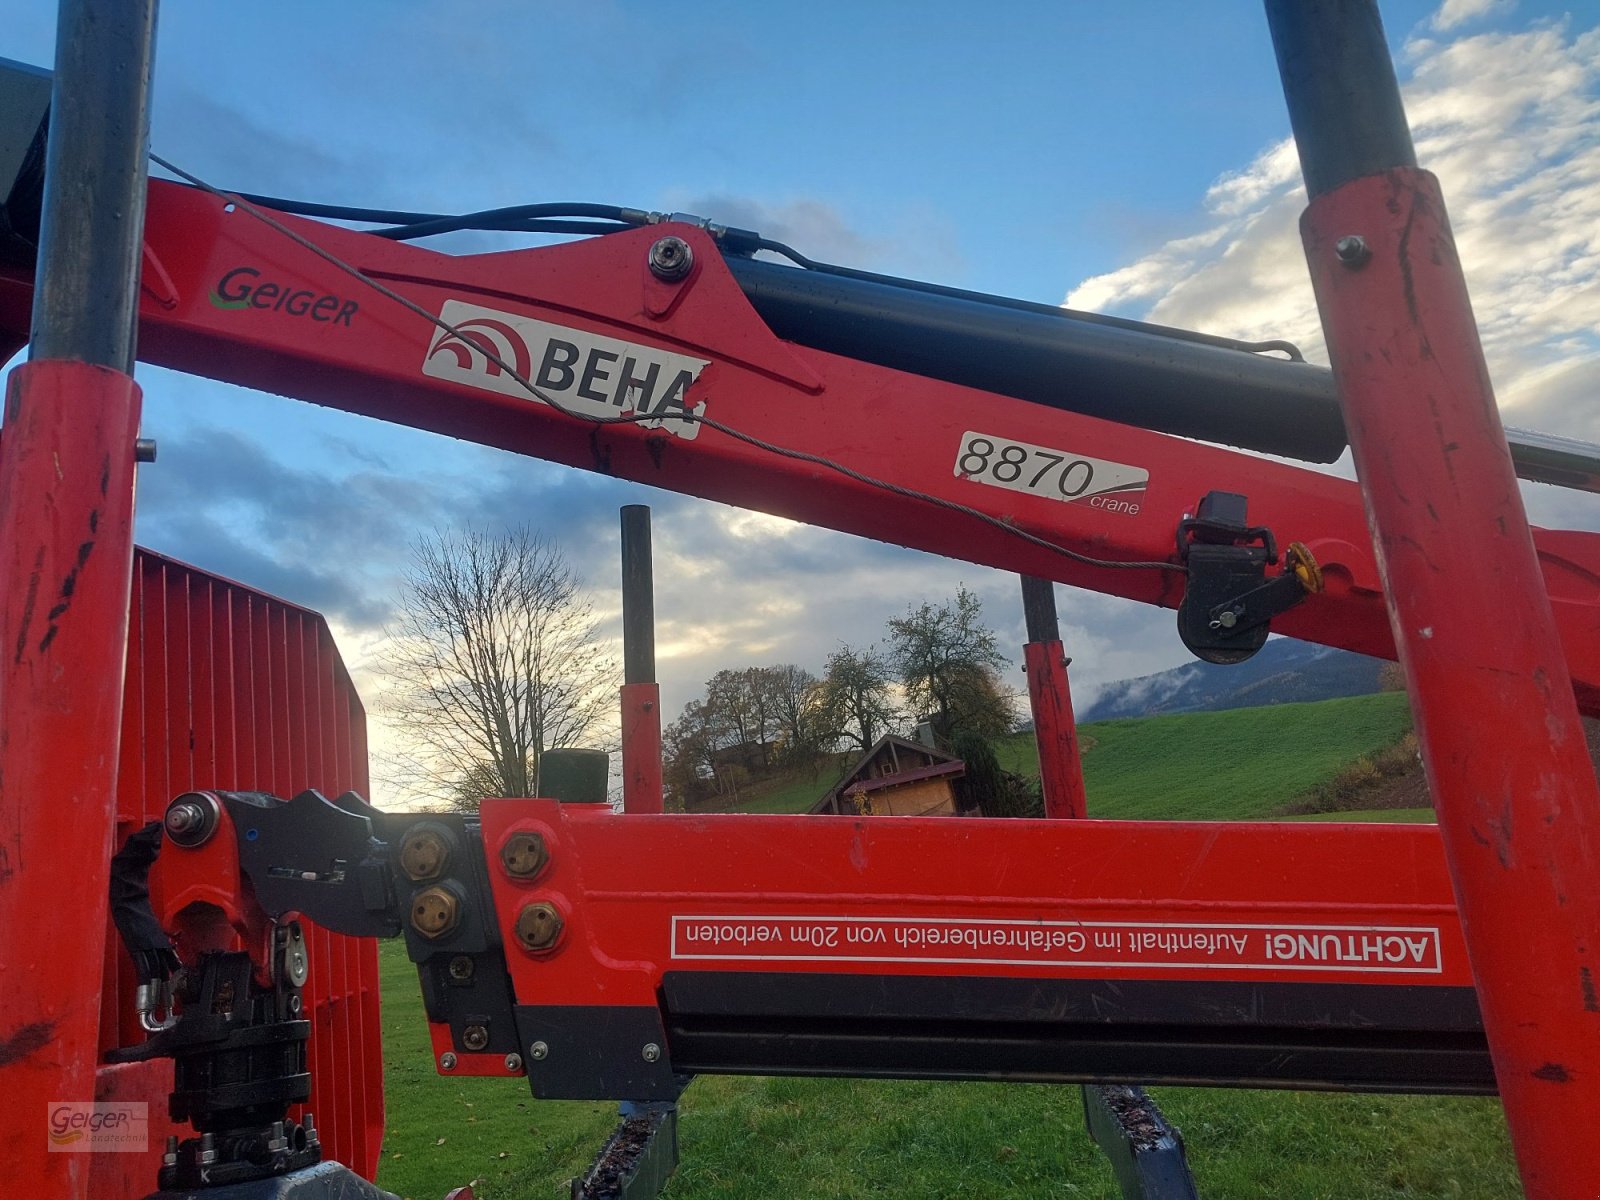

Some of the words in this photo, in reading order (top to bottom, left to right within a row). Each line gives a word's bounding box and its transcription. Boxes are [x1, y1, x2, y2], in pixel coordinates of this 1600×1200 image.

[535, 338, 695, 425] BEHA
[959, 438, 1094, 497] 8870
[1090, 496, 1140, 516] crane
[686, 924, 782, 947] verboten
[790, 925, 839, 947] 20m
[846, 926, 887, 943] von
[894, 927, 1085, 953] Gefahrenbereich
[1095, 931, 1121, 953] im
[1129, 931, 1248, 955] Aufenthalt
[1265, 933, 1429, 962] ACHTUNG!
